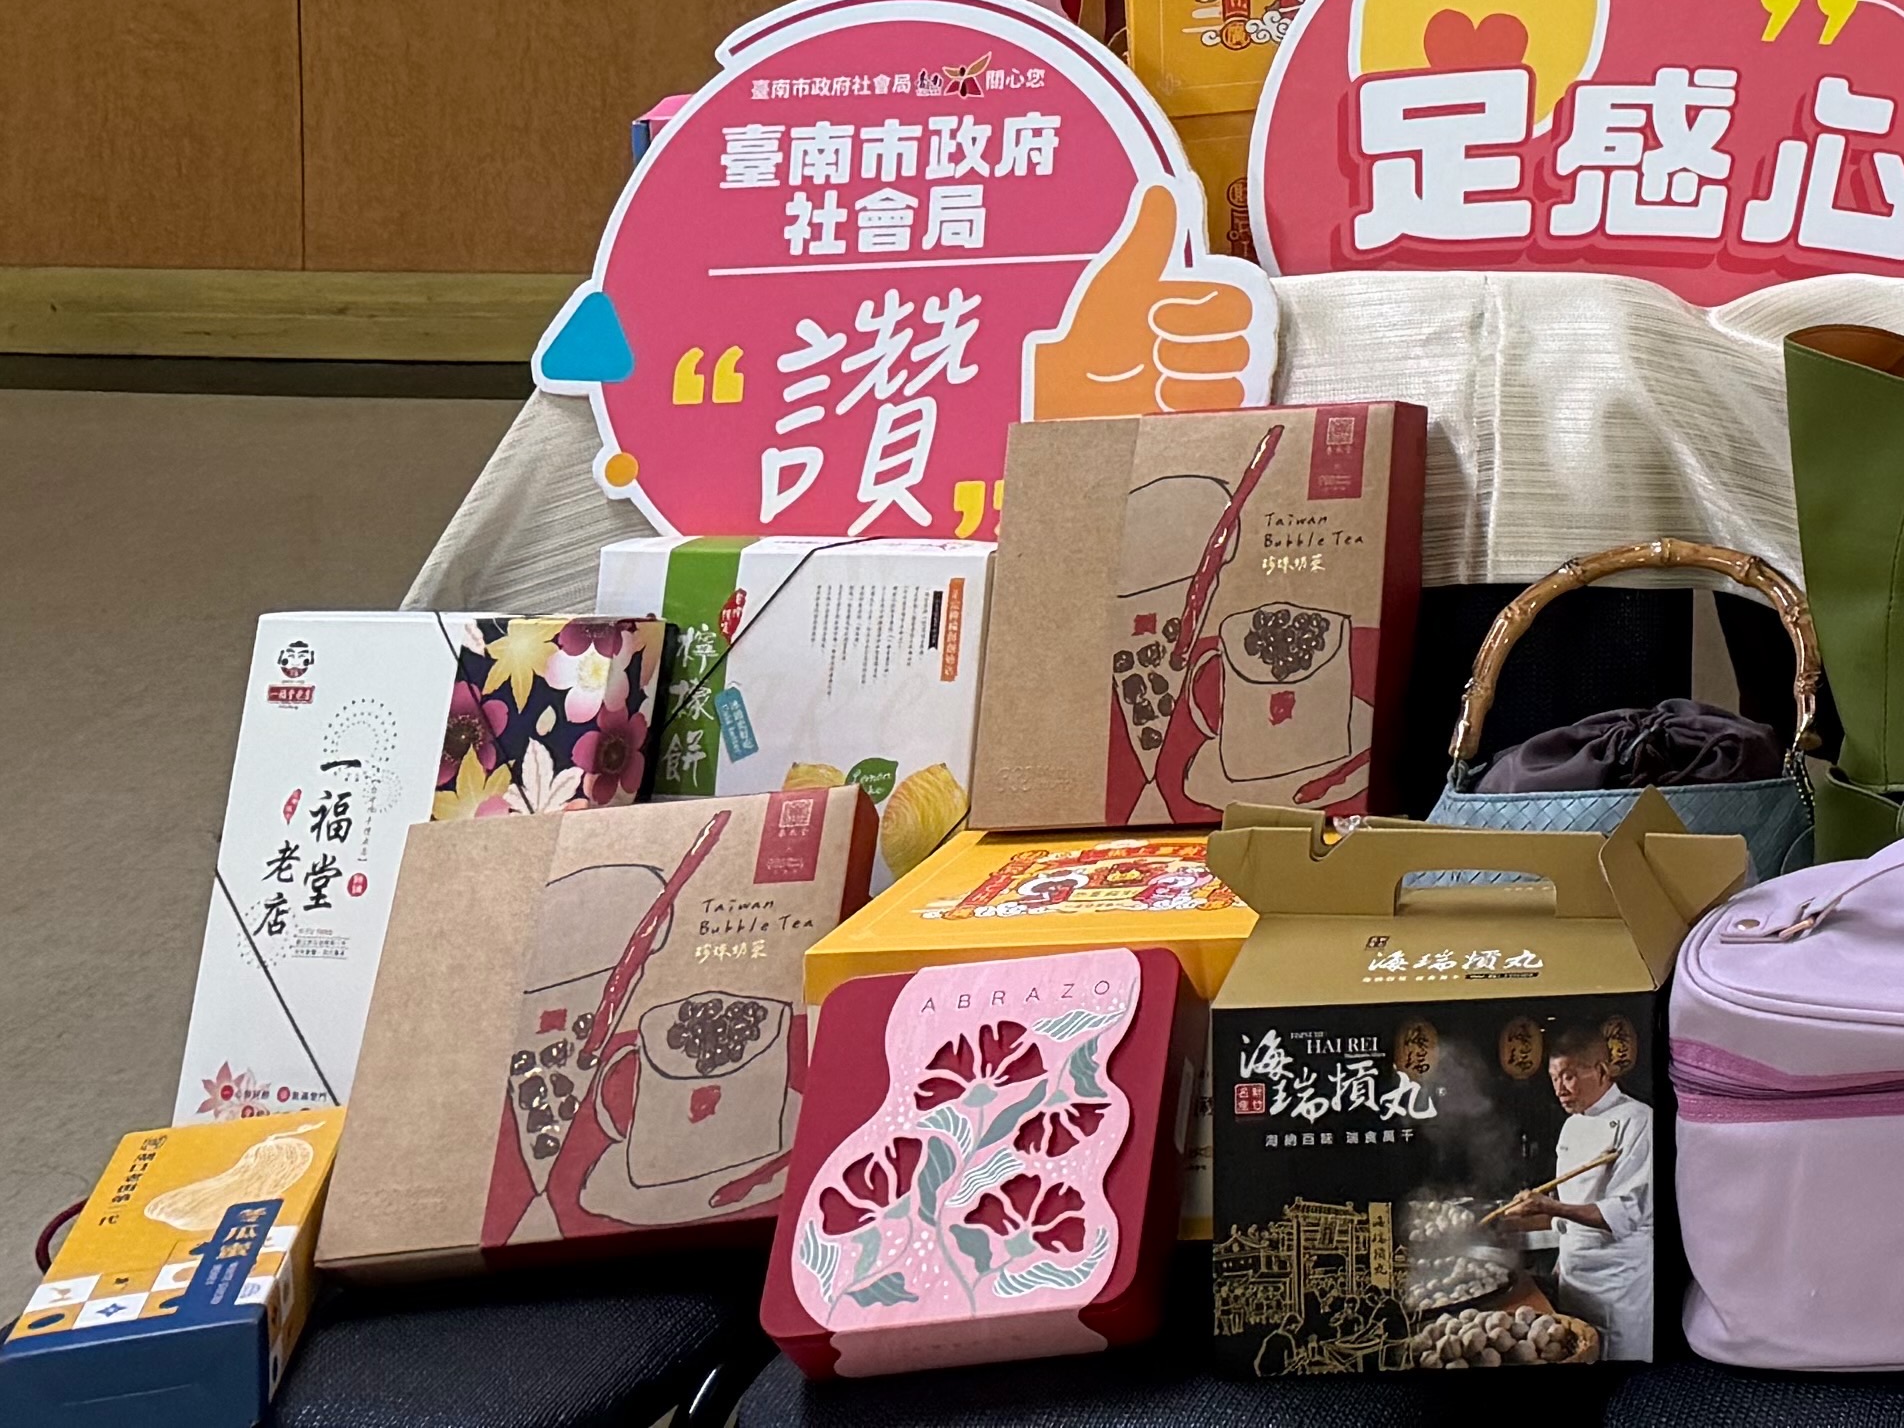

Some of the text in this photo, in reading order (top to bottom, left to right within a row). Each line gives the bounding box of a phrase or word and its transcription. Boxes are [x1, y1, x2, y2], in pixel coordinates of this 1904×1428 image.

[751, 67, 1046, 101] 臺南市政府社會局 關心您
[720, 111, 1061, 189] 臺南市政府
[784, 184, 986, 255] 社會局
[760, 286, 981, 535] 讚
[1263, 511, 1329, 528] Taiwan
[1264, 530, 1365, 548] Bubble Tea
[663, 625, 719, 787] 檸檬餅
[303, 757, 362, 911] 一福堂
[254, 840, 301, 937] 老店
[702, 897, 775, 913] Taiwan
[699, 915, 815, 936] Bubble Tea
[921, 980, 1112, 1013] ABRAZO
[1306, 1036, 1379, 1055] HAI REI
[1240, 1029, 1437, 1123] 海瑞摃丸
